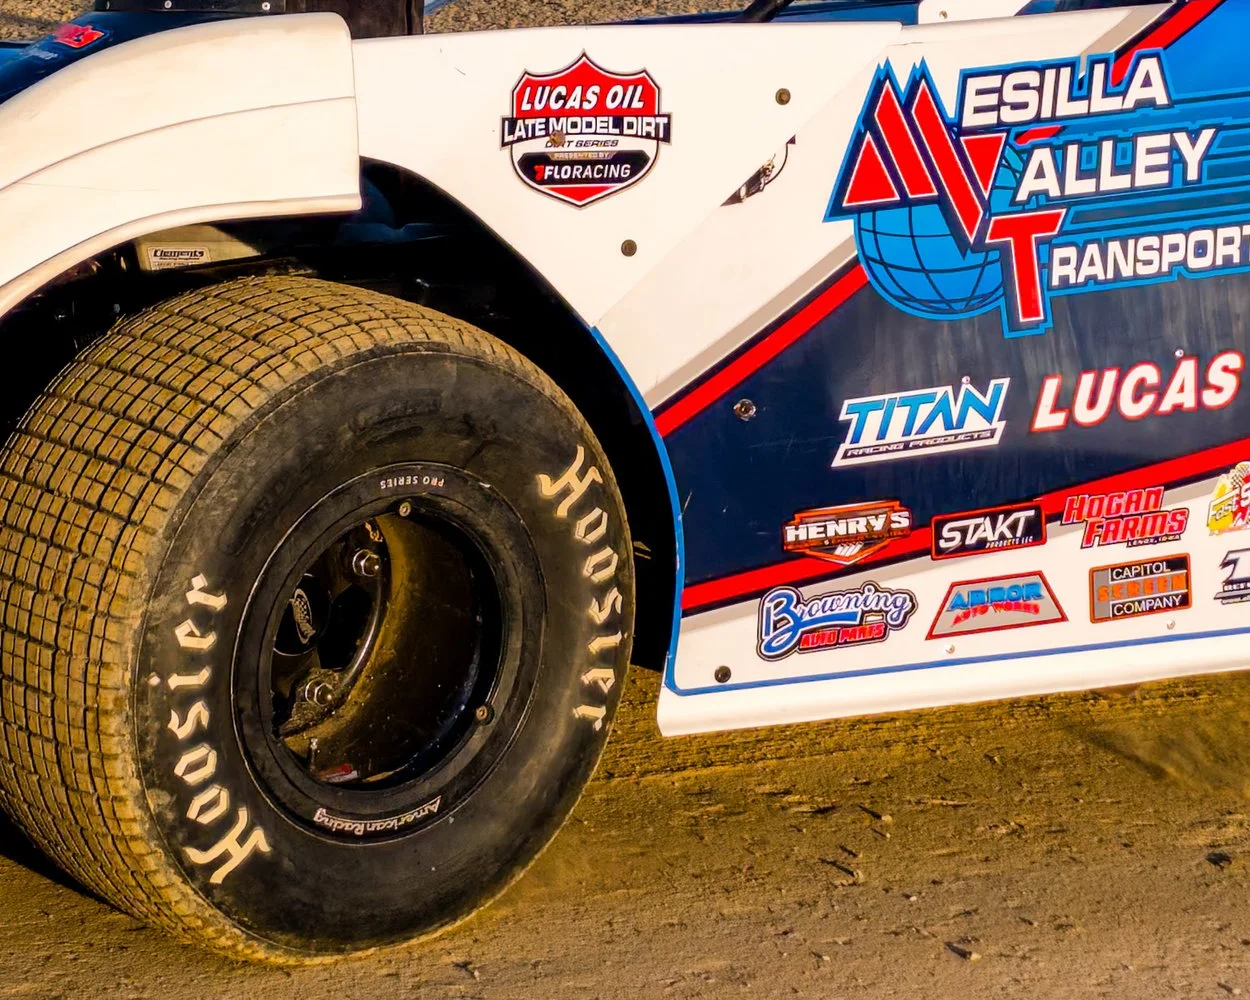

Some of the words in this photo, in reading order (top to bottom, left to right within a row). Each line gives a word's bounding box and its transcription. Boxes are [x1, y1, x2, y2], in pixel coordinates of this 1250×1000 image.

[520, 84, 600, 111] LUCAS
[605, 84, 645, 109] OIL
[503, 116, 546, 143] LATE
[549, 115, 621, 135] MODEL
[623, 116, 668, 138] DIRT
[1031, 350, 1244, 433] LUCAS
[845, 382, 1005, 445] TITAN
[846, 442, 904, 457] RACING
[908, 431, 992, 448] PRODUCTS
[380, 476, 419, 490] SERIES
[423, 475, 445, 487] PRO
[1062, 486, 1165, 526] HOGAN
[939, 510, 1036, 549] STAKT
[1081, 508, 1190, 549] FARMS
[1112, 560, 1171, 581] CAPITOL
[540, 445, 631, 730] Hoosier
[1097, 572, 1187, 604] SCREEN
[761, 585, 912, 656] Browning
[1113, 594, 1183, 616] COMPANY
[800, 629, 838, 649] AUTO
[839, 622, 886, 643] PARTS
[149, 573, 272, 884] Hoosier
[313, 807, 366, 836] Racing
[367, 794, 442, 831] American
